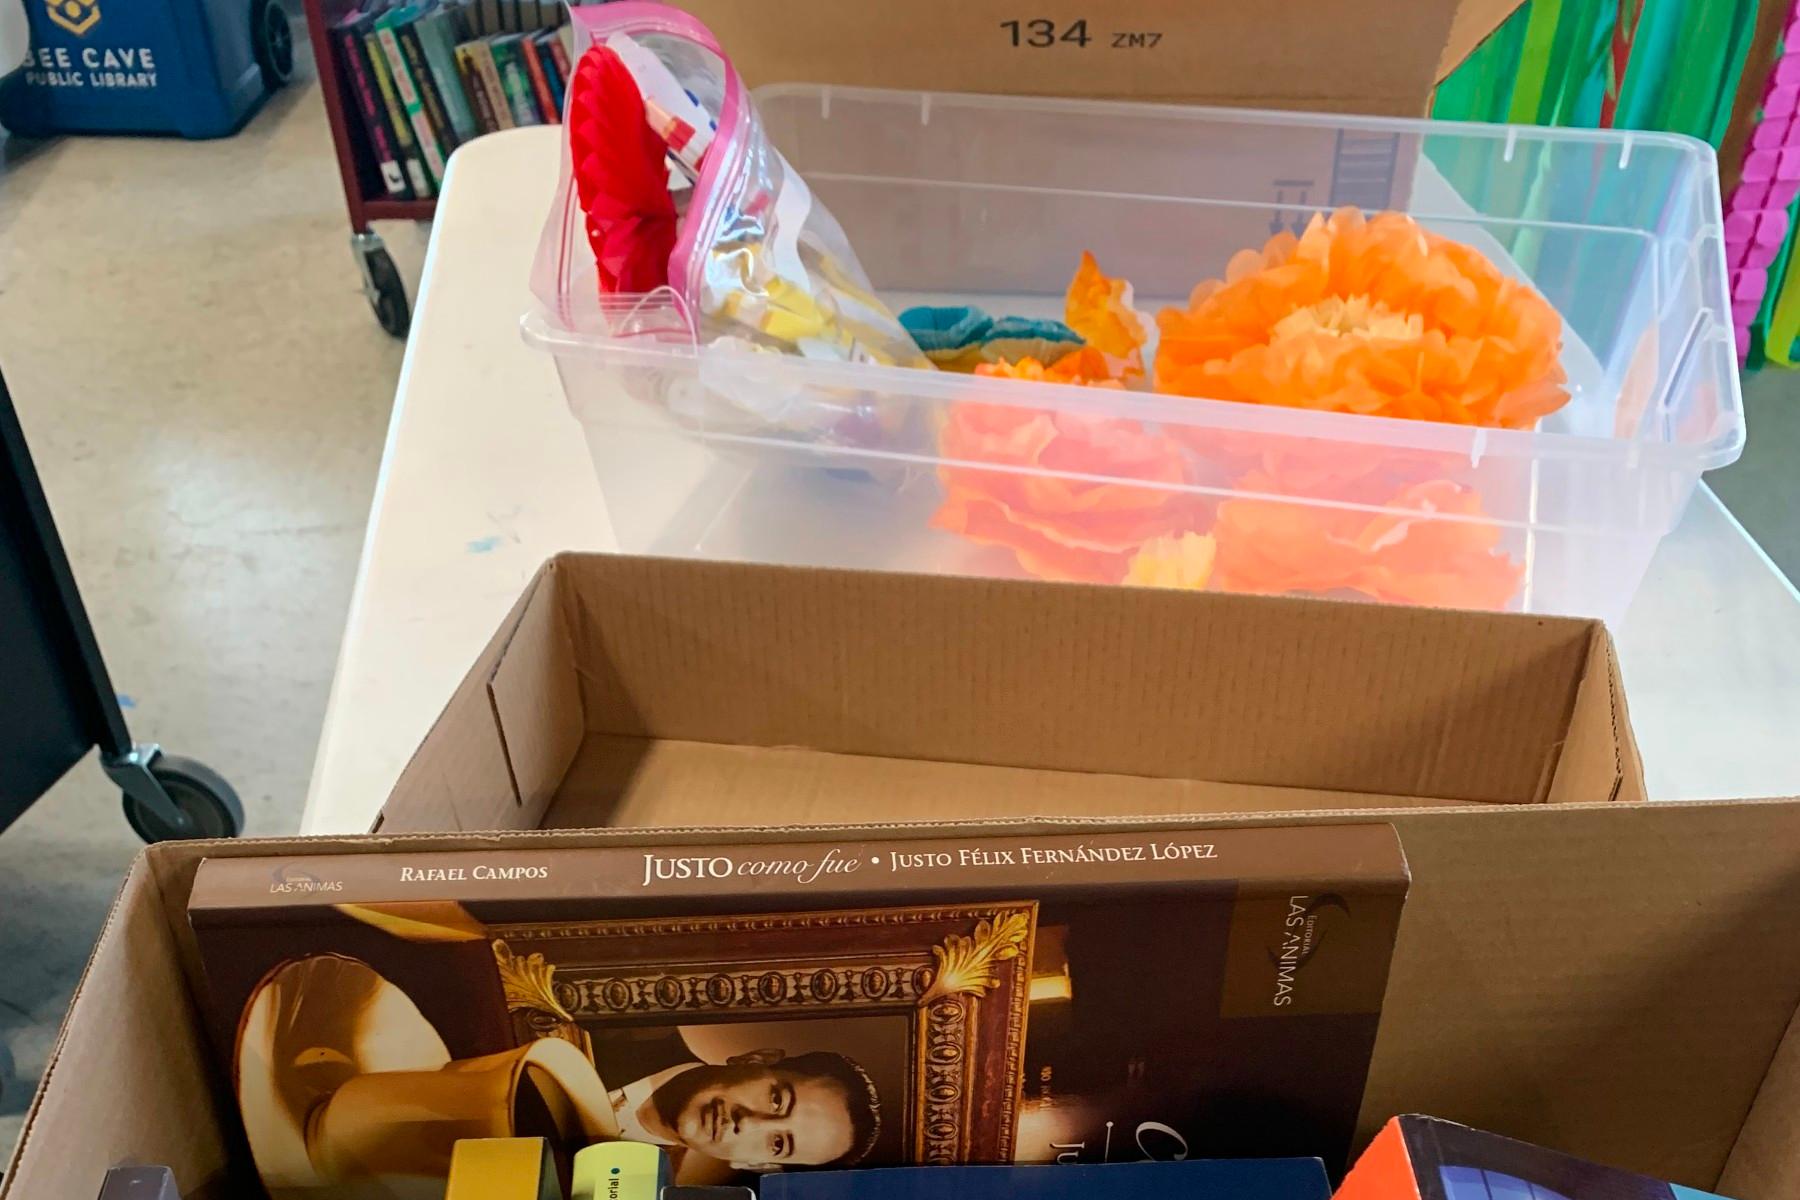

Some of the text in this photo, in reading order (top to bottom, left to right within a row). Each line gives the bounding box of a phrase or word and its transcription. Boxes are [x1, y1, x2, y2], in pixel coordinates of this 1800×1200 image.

[1001, 19, 1162, 49] 134 ZM7
[82, 48, 155, 69] CAVE
[26, 72, 157, 87] PUBLIC LIBRARY
[643, 849, 862, 886] JUSTO como fue
[890, 842, 1218, 872] JUSTO FÉLIX FERNÁNDEZ LÓPEZ
[400, 865, 548, 882] RAFAEL CAMPOS
[270, 882, 292, 893] LAS
[1286, 895, 1309, 926] LAS
